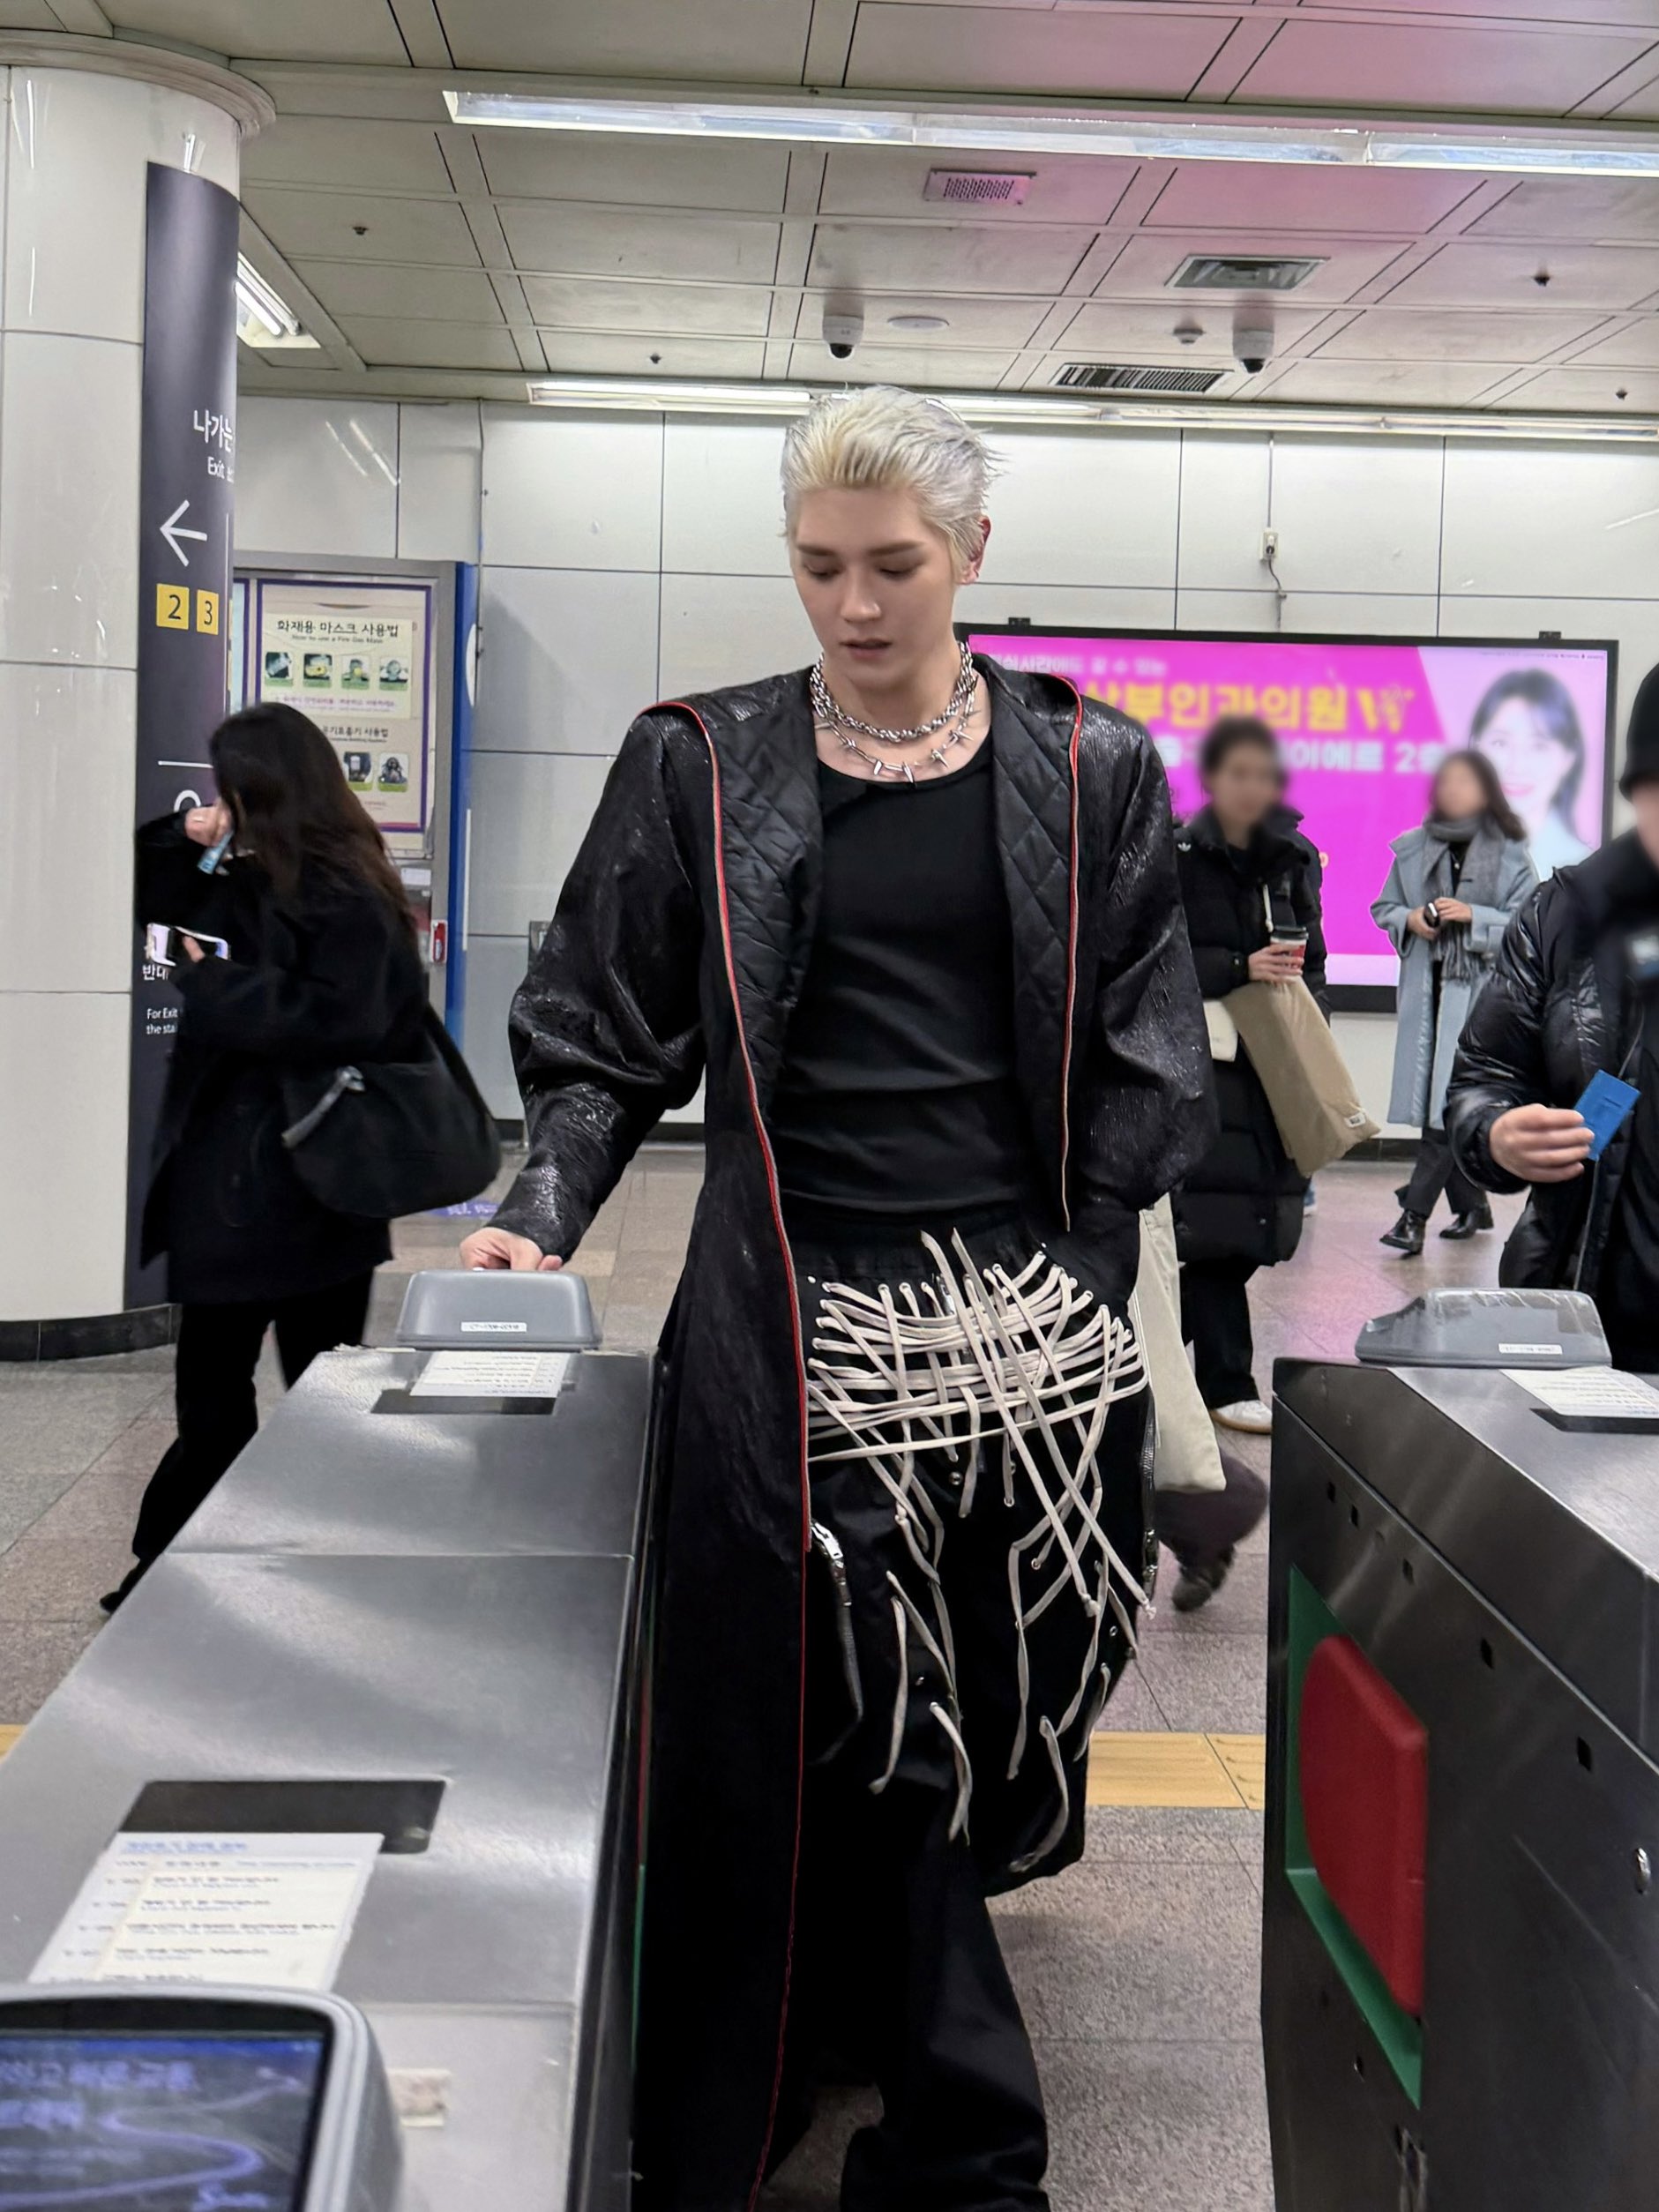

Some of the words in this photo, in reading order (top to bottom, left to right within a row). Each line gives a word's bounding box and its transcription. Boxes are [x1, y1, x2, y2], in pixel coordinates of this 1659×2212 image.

[193, 409, 234, 452] 나가는
[207, 456, 225, 480] Exit
[168, 594, 182, 620] 2
[203, 600, 213, 625] 3
[277, 619, 316, 634] 화재용
[319, 621, 358, 635] 마스크
[362, 622, 399, 638] 사용법
[146, 1008, 161, 1020] For
[146, 1024, 161, 1035] the
